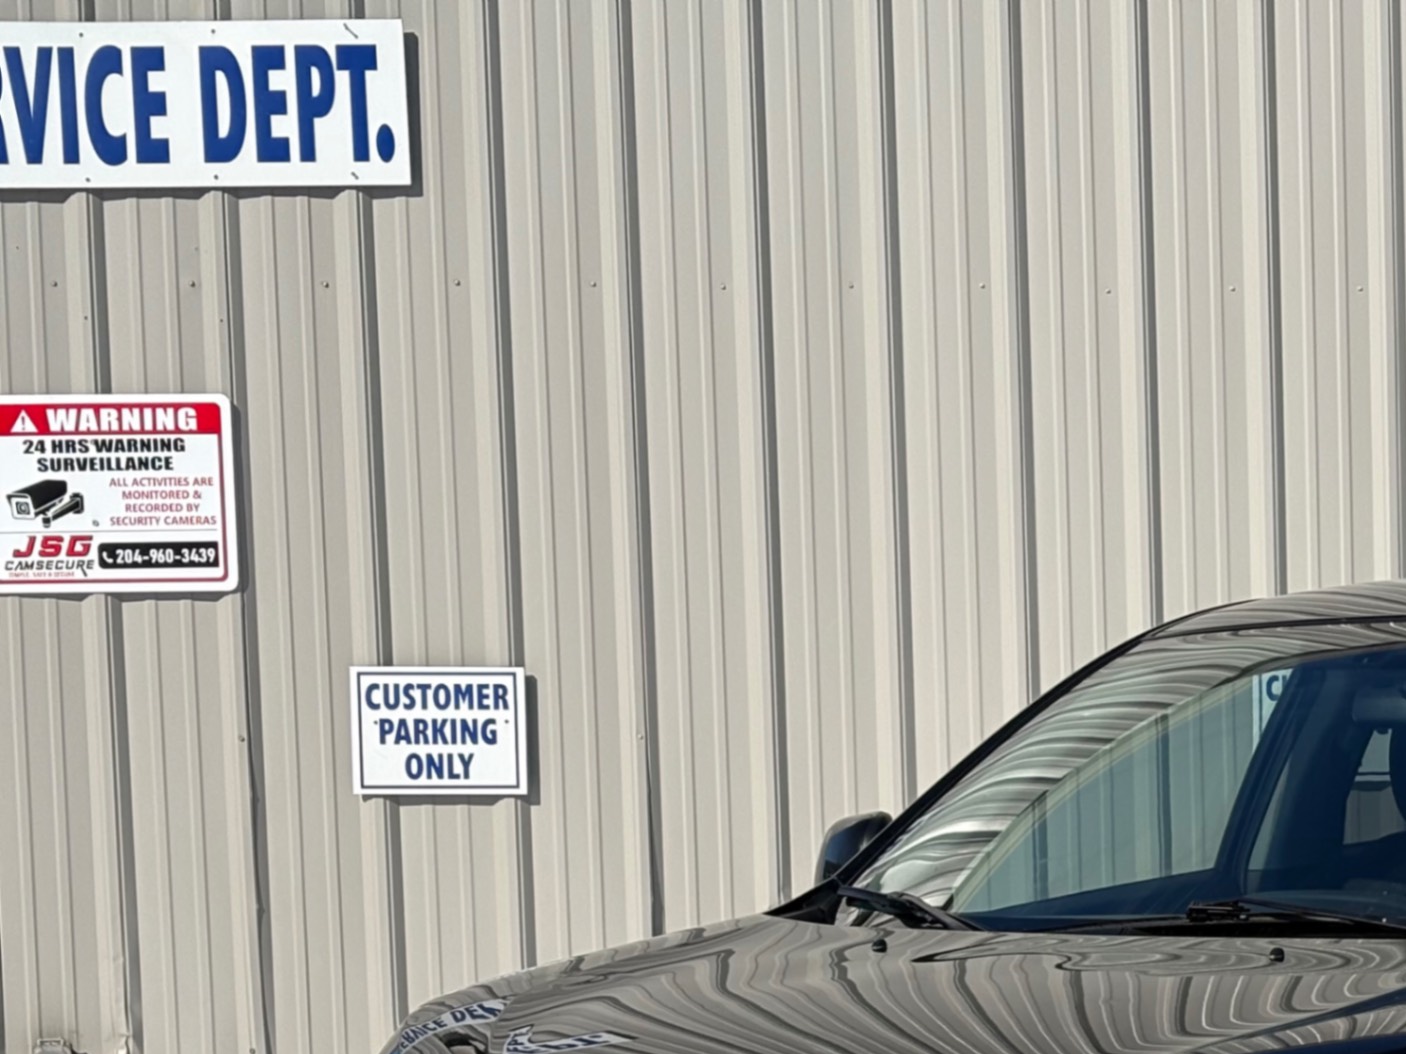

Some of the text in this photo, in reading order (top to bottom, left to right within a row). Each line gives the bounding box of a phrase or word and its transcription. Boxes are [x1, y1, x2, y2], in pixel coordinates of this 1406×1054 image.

[198, 45, 395, 164] DEPT.
[46, 407, 198, 432] WARNING
[23, 438, 186, 454] 24 HRS WARNING
[37, 456, 174, 472] SURVEILLANCE
[109, 477, 214, 487] ALL ACTIVITIES ARE
[122, 490, 202, 500] MONITORED &
[125, 503, 200, 513] RECORDED BY
[109, 515, 217, 526] SECURITY CAMERAS
[12, 535, 94, 558] JSG
[115, 548, 216, 564] 204-960-3439
[4, 559, 95, 577] CAMSECURE
[365, 683, 509, 710] CUSTOMER
[379, 718, 497, 745] PARKING
[405, 753, 474, 780] ONLY
